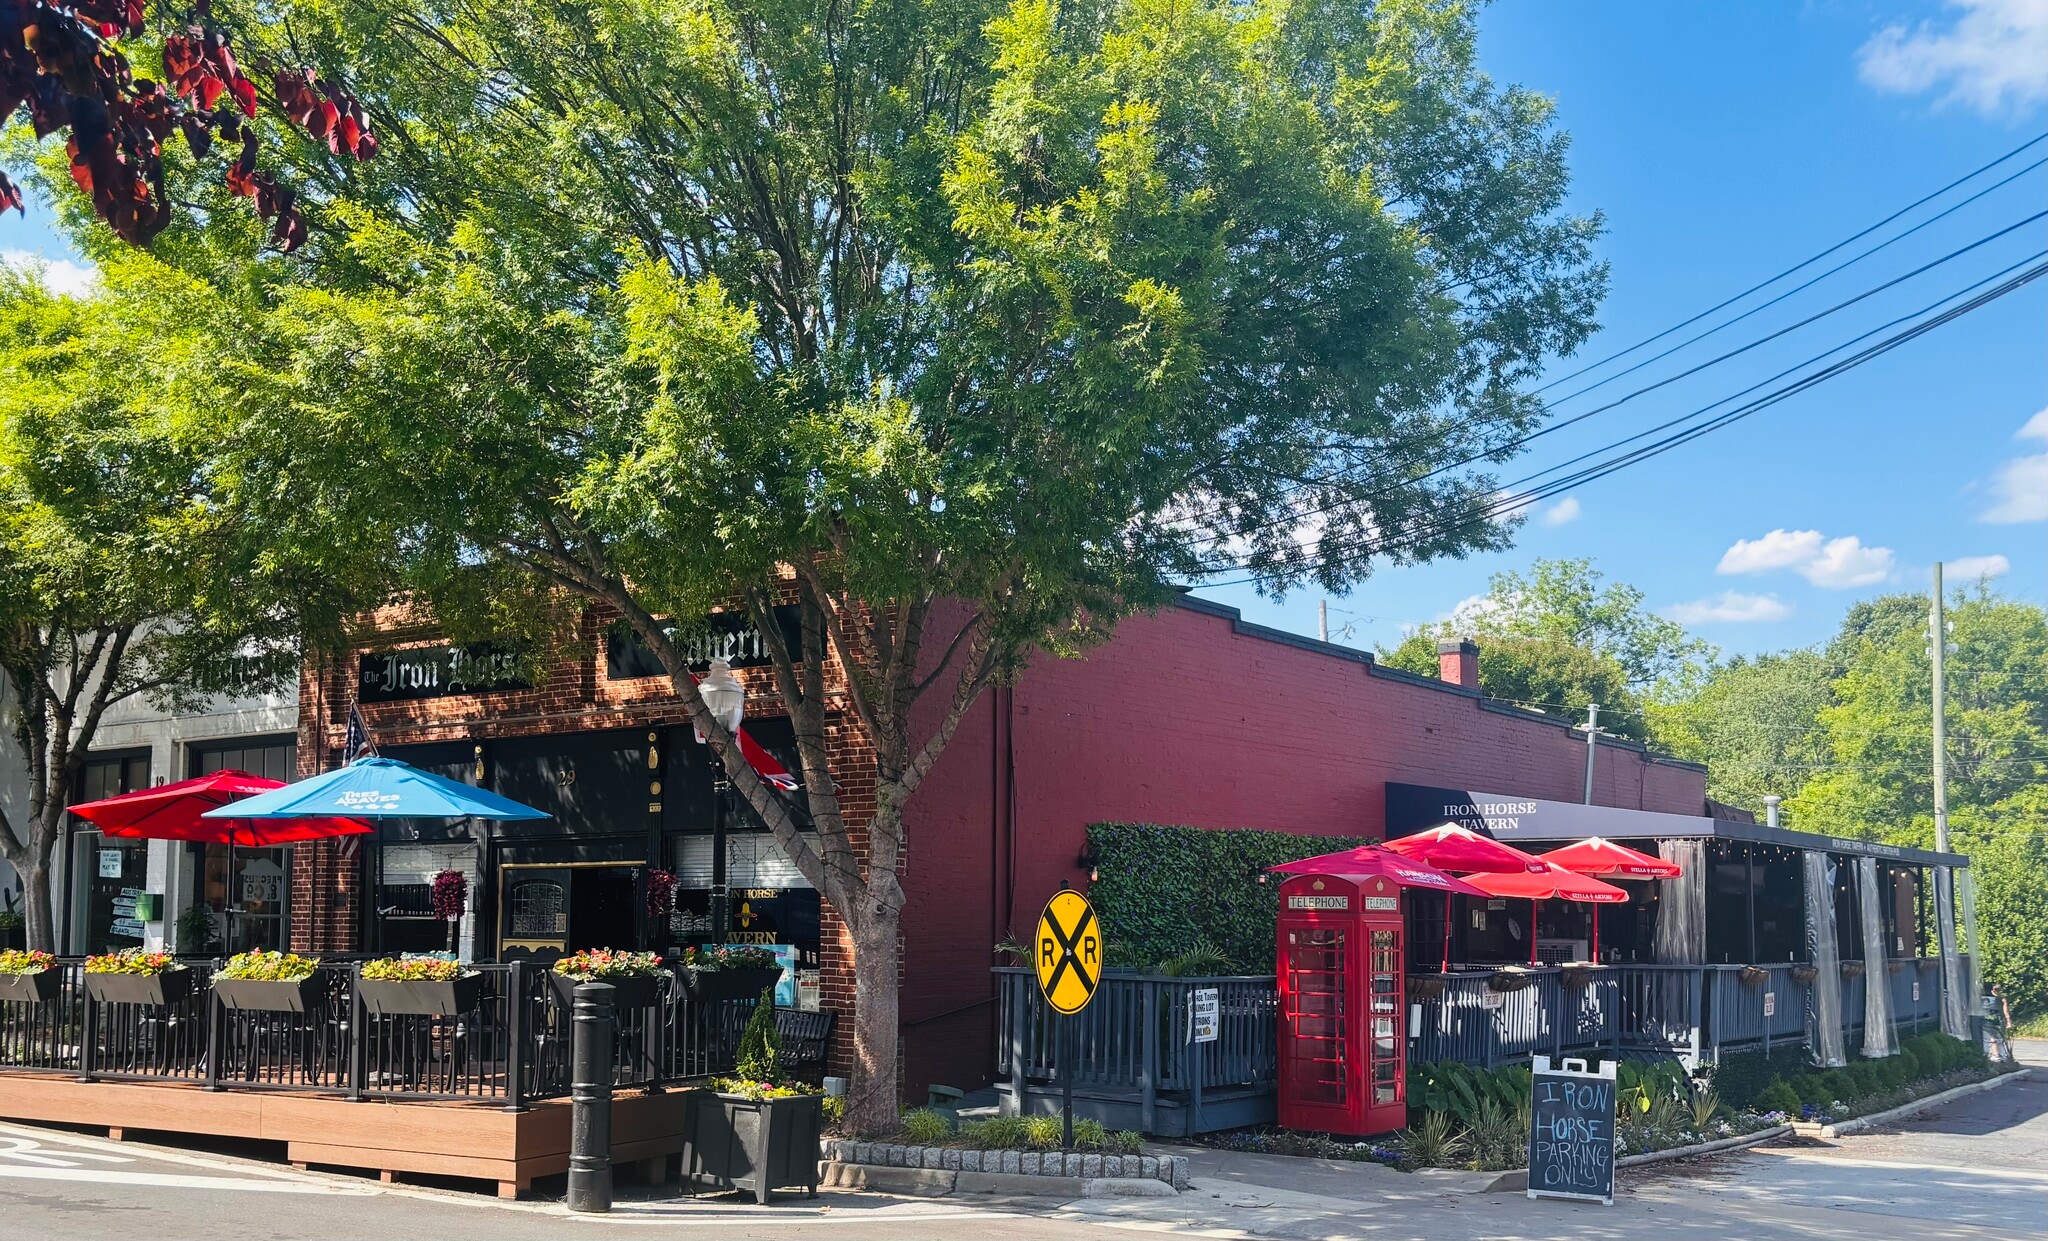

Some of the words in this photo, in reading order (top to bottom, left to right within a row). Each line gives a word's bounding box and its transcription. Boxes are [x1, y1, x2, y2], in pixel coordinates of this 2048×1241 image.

[364, 671, 379, 684] The
[380, 654, 440, 693] Iron
[156, 775, 165, 788] 19
[558, 769, 576, 786] 29
[1443, 804, 1481, 816] IRON
[1484, 802, 1537, 815] HORSE
[1460, 817, 1520, 830] TAVERN
[743, 888, 778, 899] HORSE
[1290, 897, 1348, 908] TELEPHONE
[1366, 898, 1396, 909] TELEPHONE
[725, 931, 778, 945] AVERN
[1196, 1016, 1211, 1026] TRONS
[1538, 1082, 1609, 1112] IRON
[1536, 1111, 1611, 1143] HORSE
[1537, 1141, 1609, 1174] PARKING
[1544, 1164, 1598, 1188] ONLY
